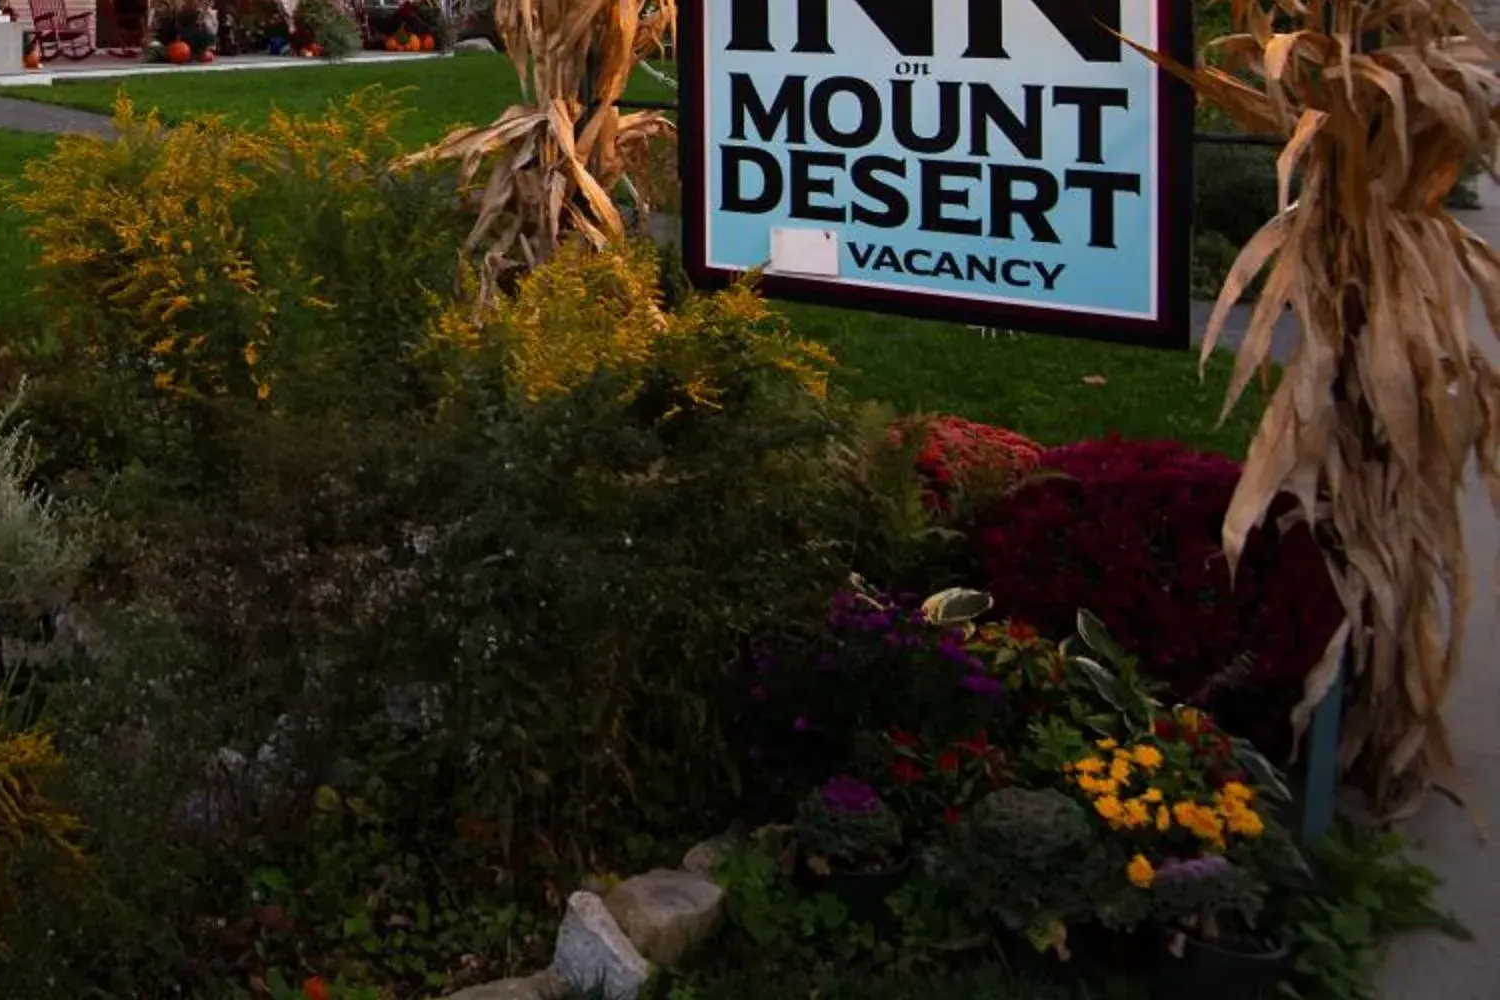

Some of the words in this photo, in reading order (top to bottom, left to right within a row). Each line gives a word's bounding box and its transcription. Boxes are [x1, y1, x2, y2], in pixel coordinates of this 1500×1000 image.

[894, 60, 932, 76] on
[727, 71, 1129, 165] MOUNT
[719, 144, 1141, 249] DESERT
[846, 241, 1066, 291] VACANCY
